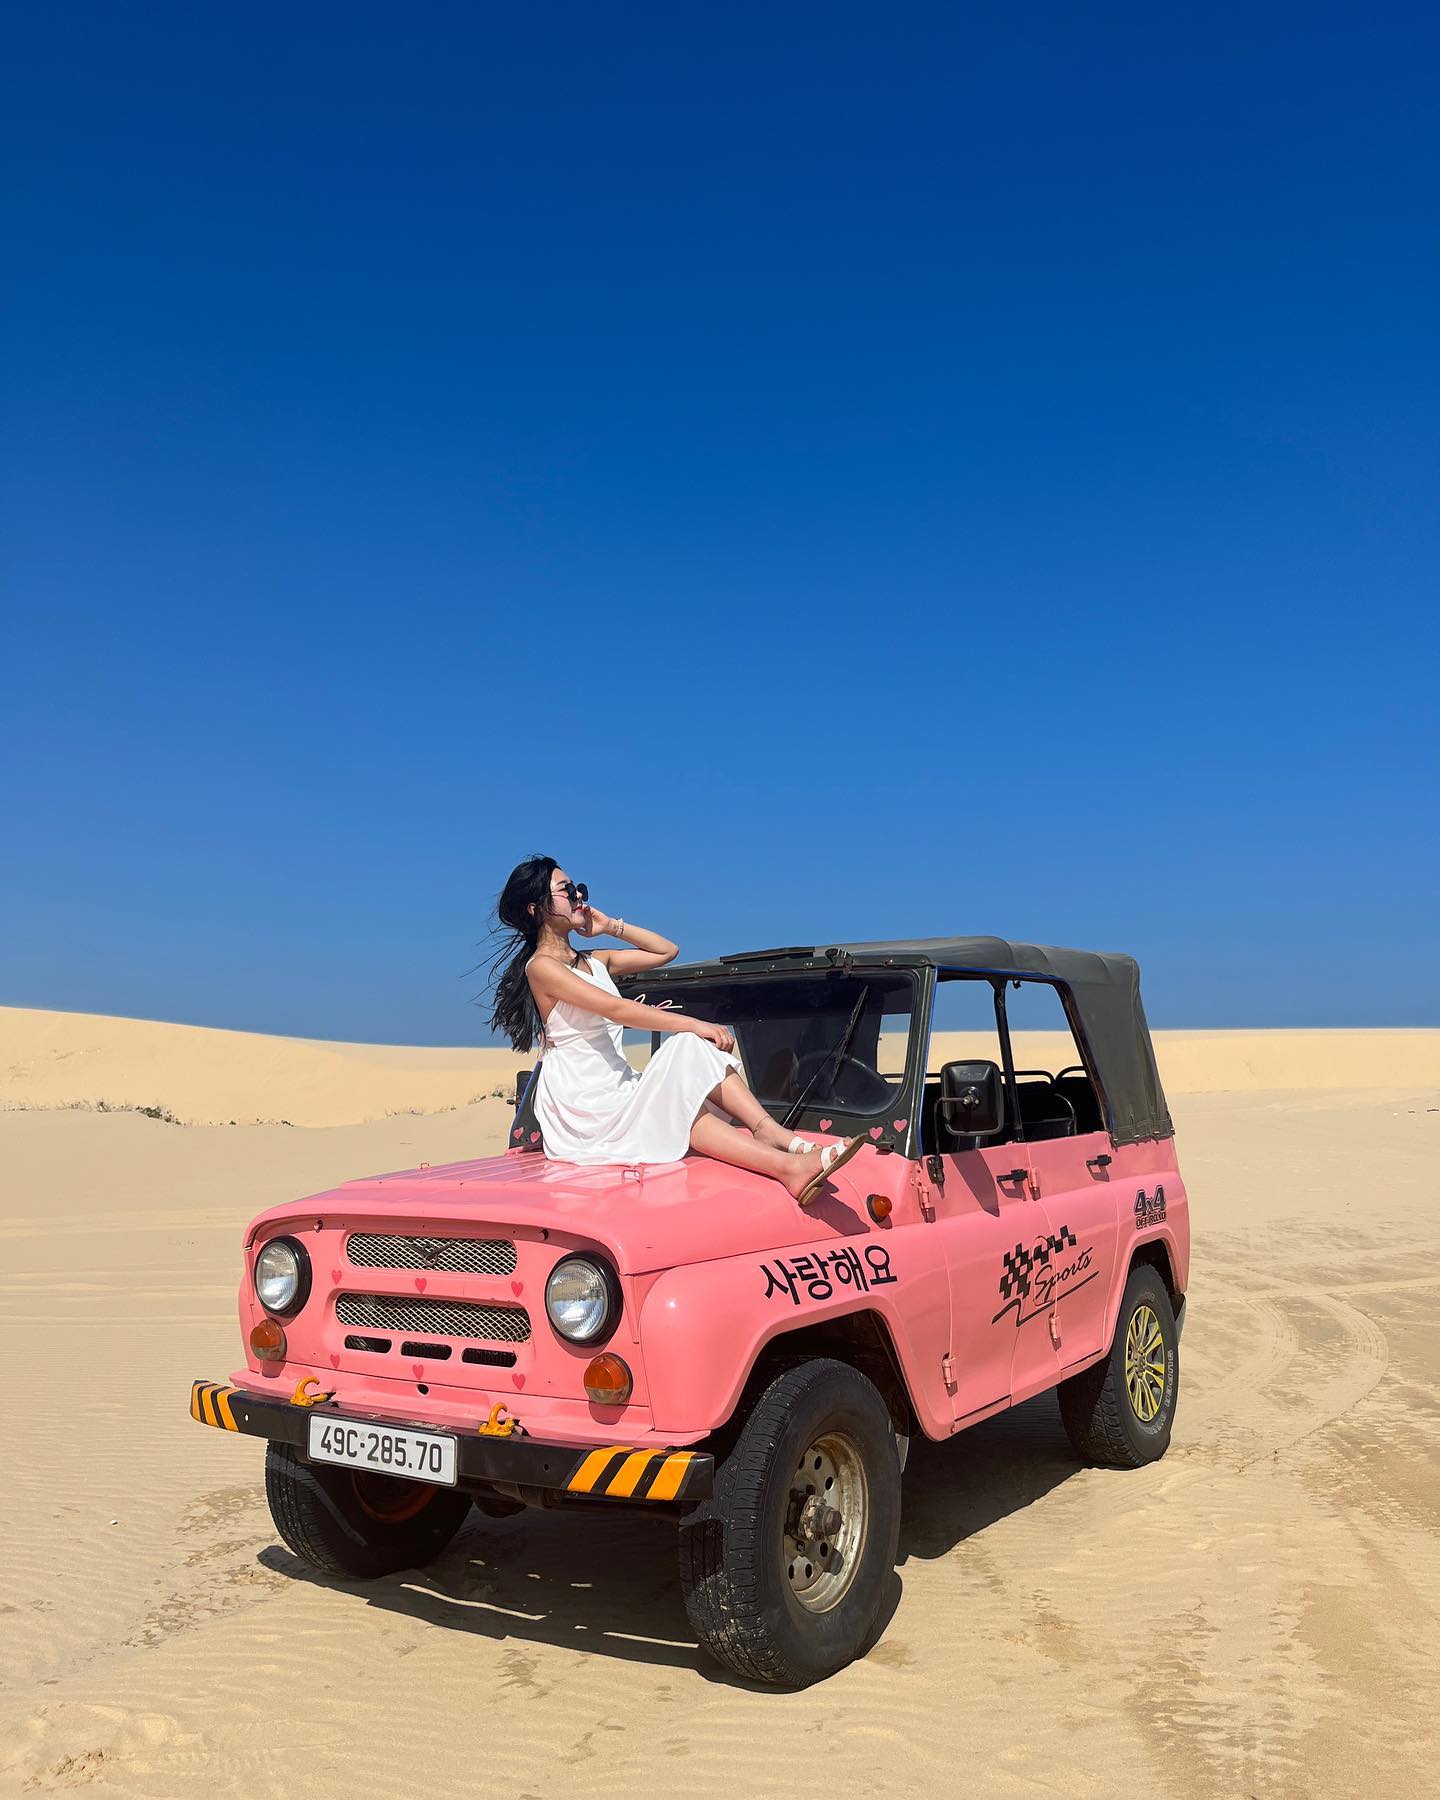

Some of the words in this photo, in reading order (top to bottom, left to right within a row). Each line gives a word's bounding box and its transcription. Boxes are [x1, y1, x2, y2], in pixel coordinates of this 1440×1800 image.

[1134, 1184, 1167, 1217] 4x4
[759, 1245, 898, 1305] 사랑해요
[1034, 1246, 1093, 1302] Sports
